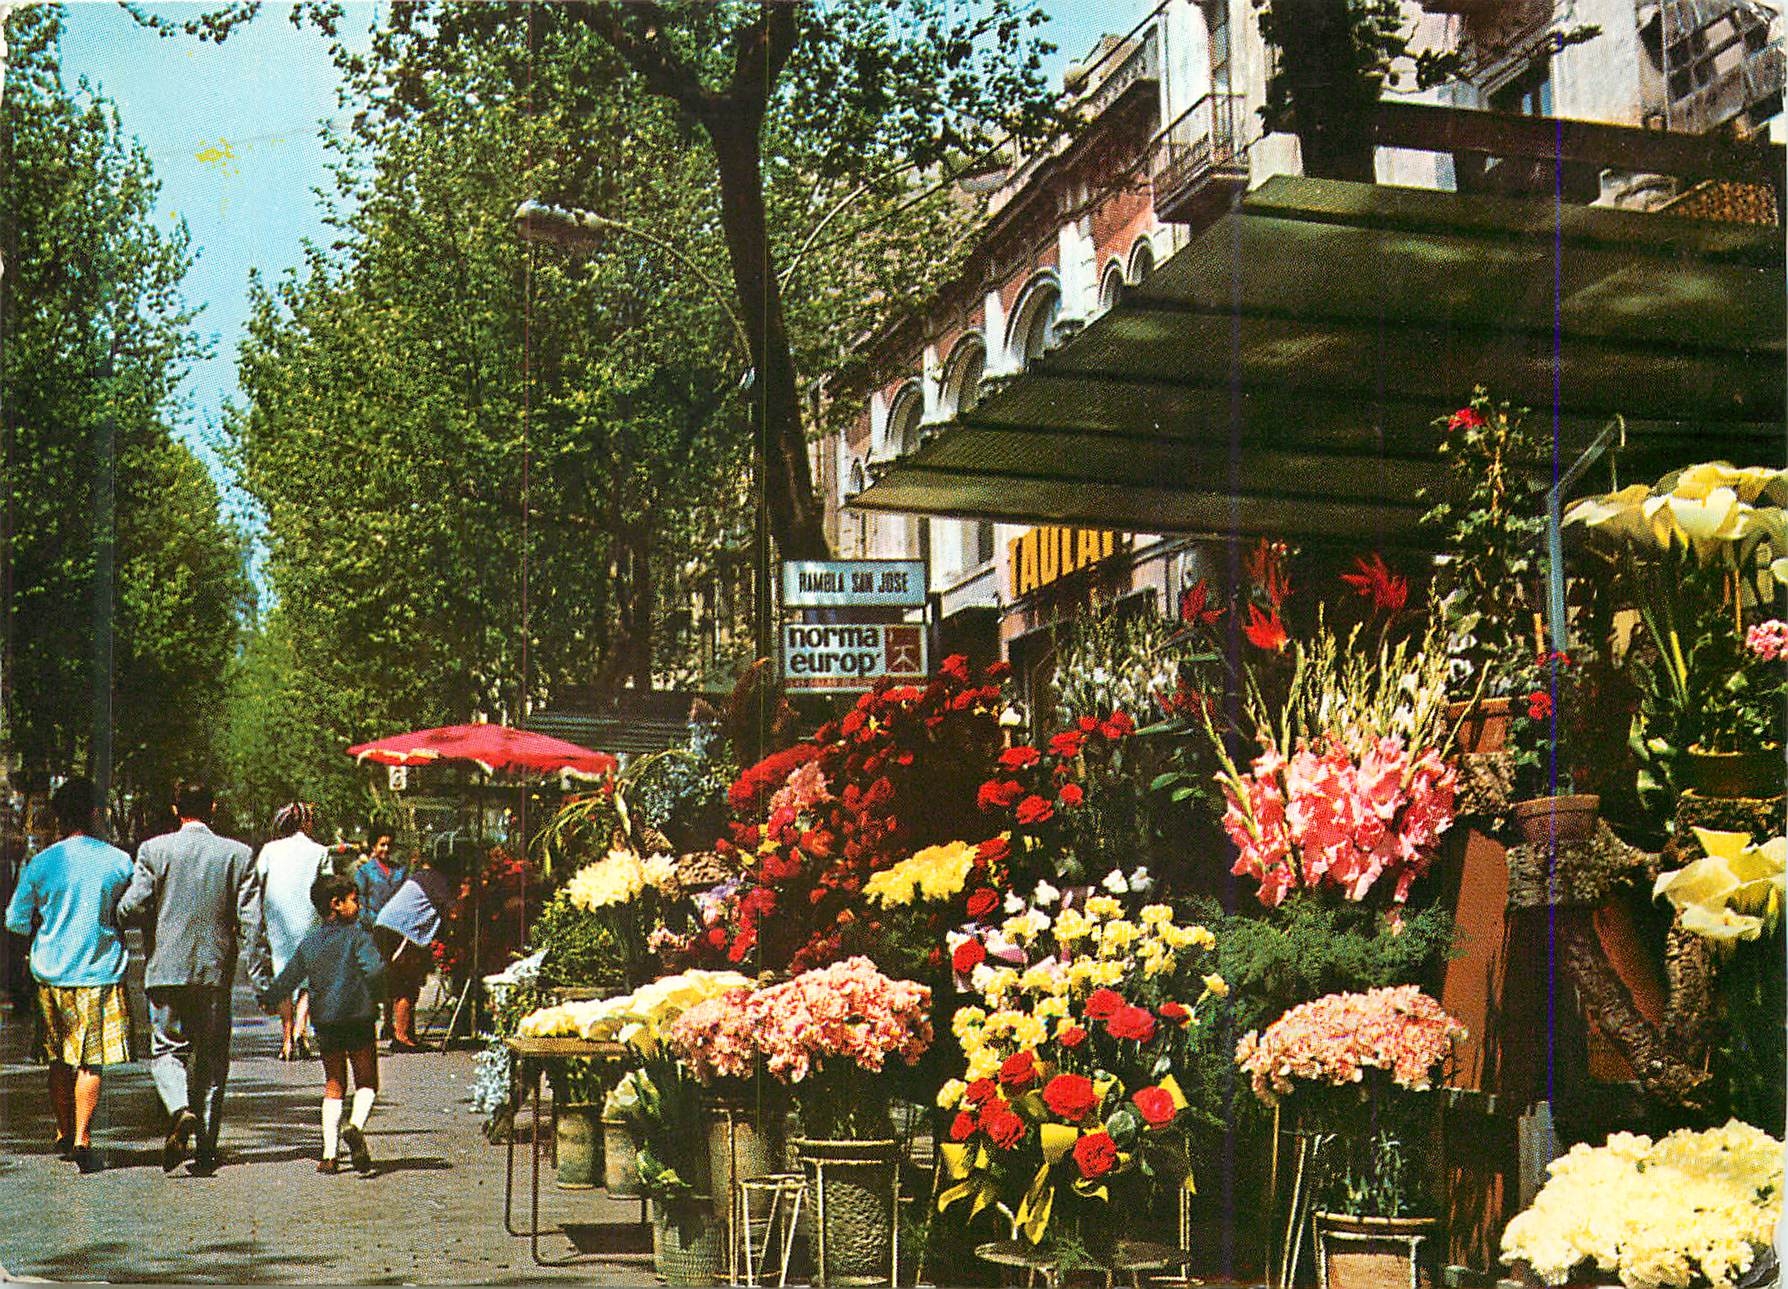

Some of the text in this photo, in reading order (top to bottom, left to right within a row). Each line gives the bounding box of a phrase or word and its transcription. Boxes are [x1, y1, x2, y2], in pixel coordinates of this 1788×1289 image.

[799, 572, 909, 593] RAMBLA SAN JOSE
[788, 626, 879, 648] norma
